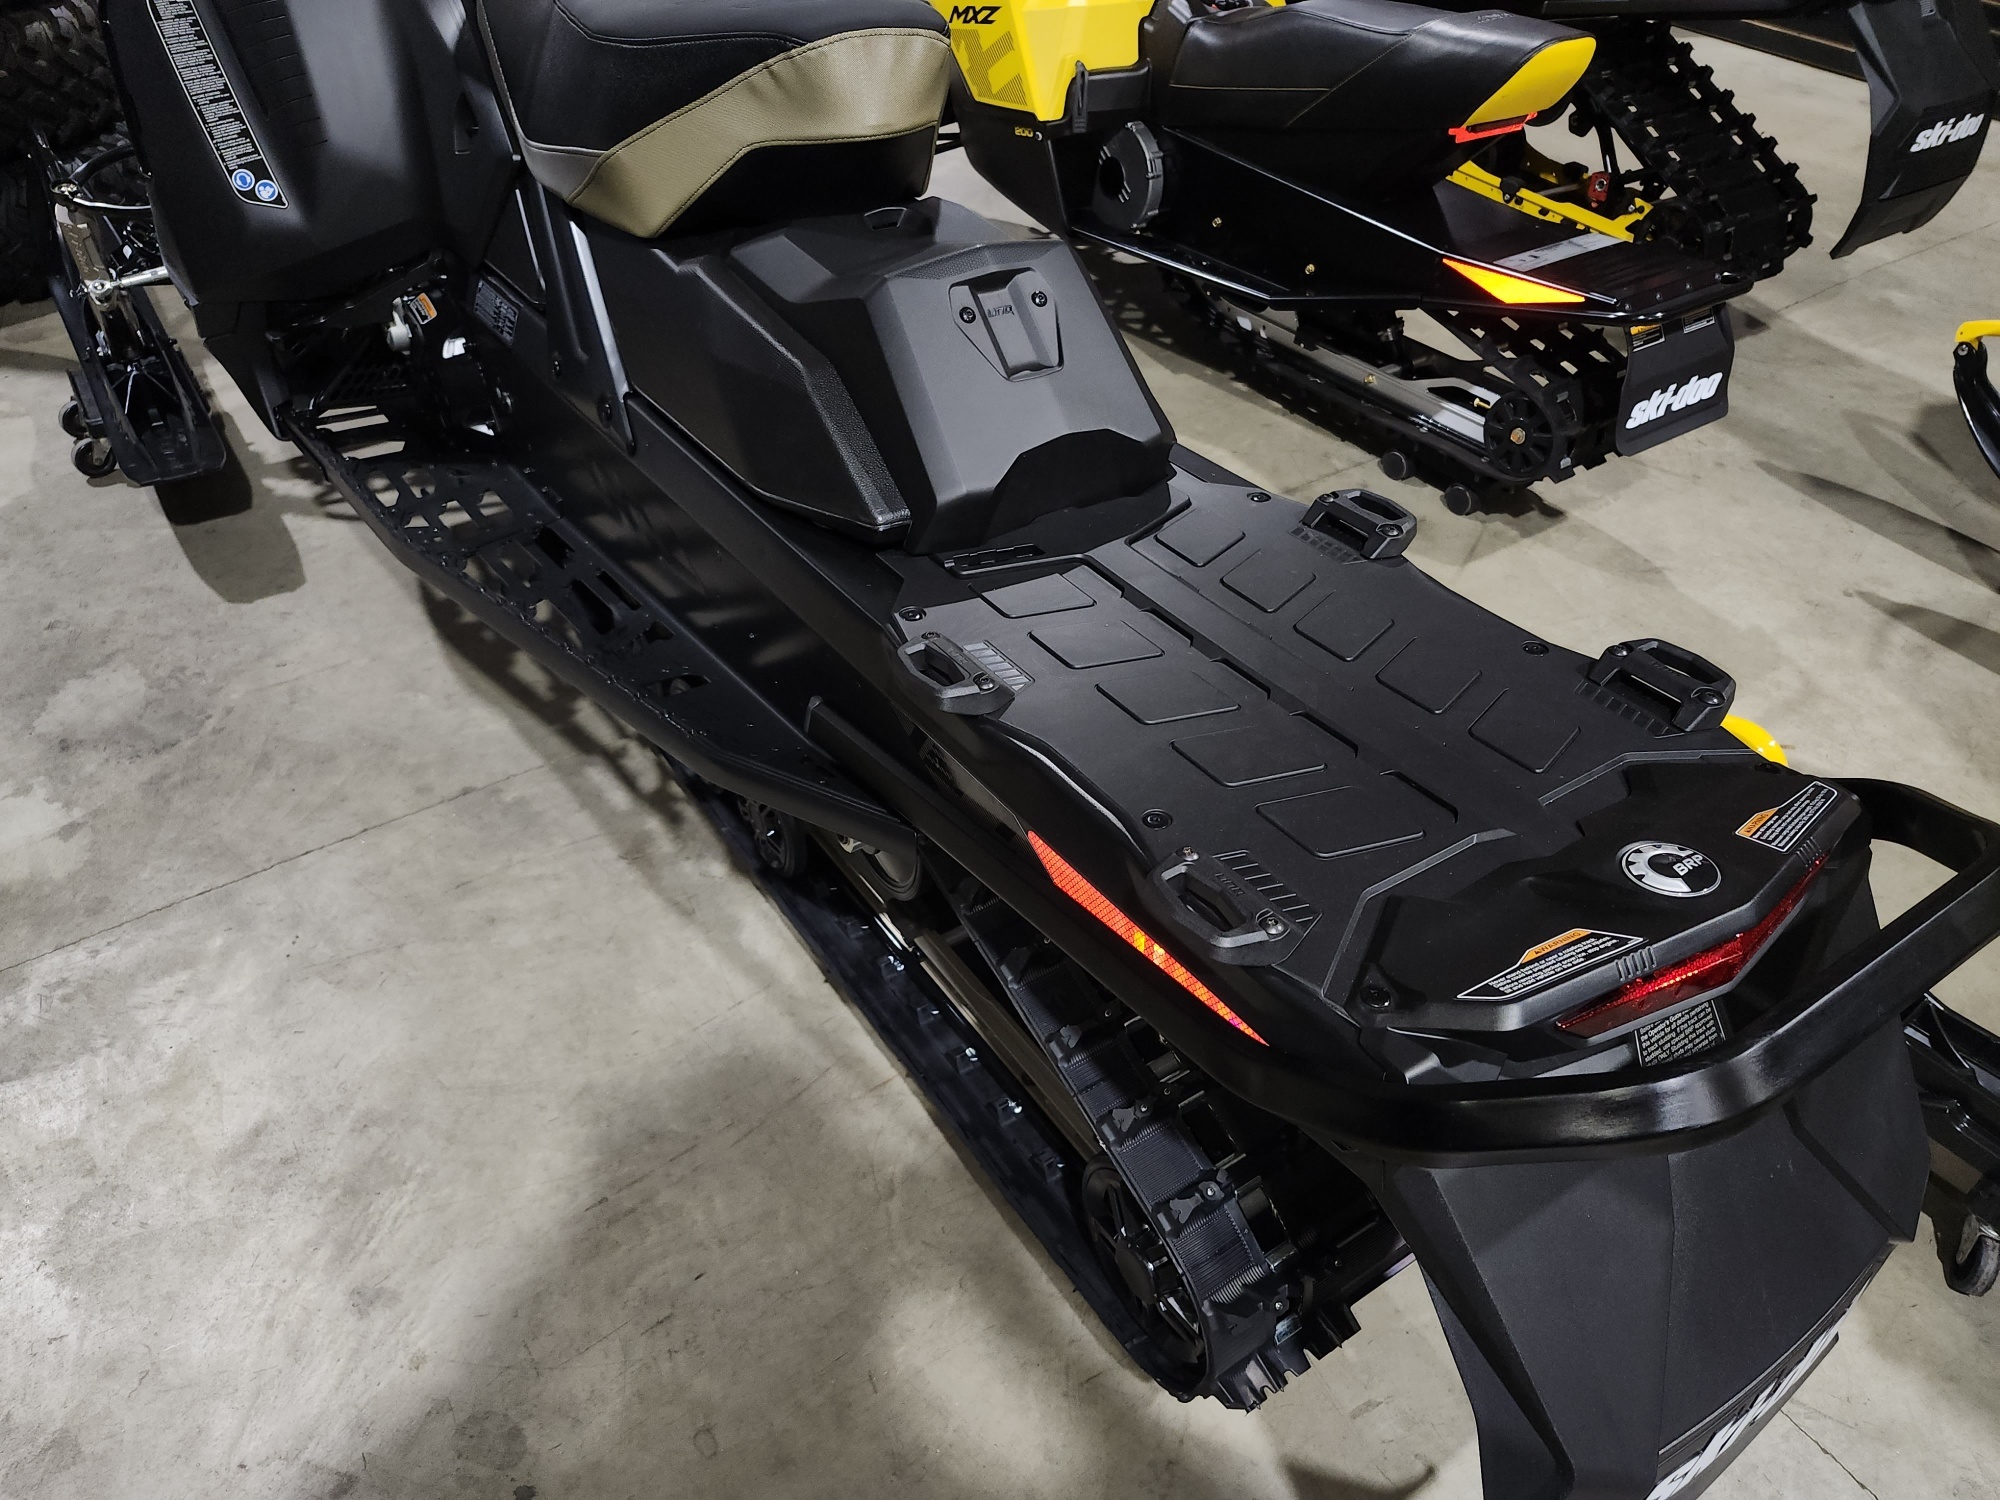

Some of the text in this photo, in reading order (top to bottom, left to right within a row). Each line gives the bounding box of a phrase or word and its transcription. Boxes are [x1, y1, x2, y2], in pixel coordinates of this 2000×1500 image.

[949, 5, 1002, 24] MXZ
[1625, 372, 1723, 430] ski-doo
[1672, 854, 1703, 876] BRP
